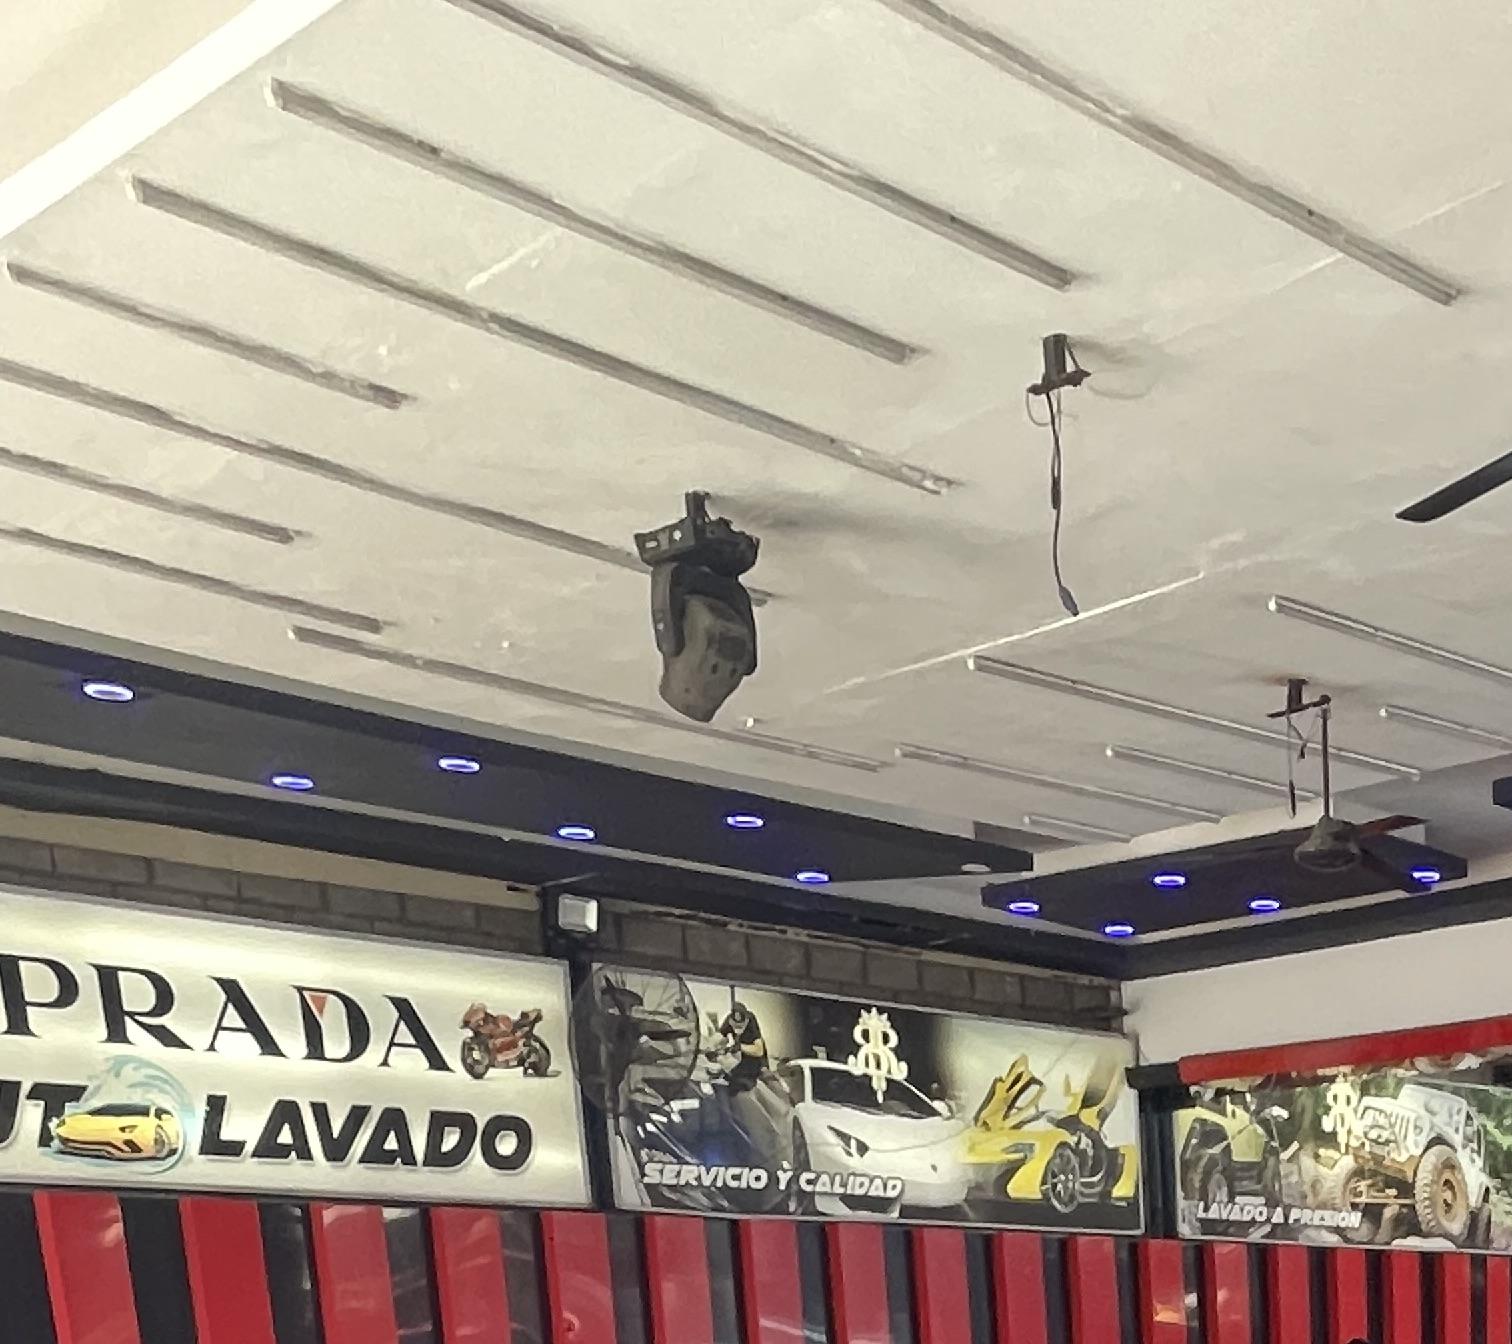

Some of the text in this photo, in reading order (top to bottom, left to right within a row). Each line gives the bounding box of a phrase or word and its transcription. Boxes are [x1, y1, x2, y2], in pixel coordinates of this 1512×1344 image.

[0, 953, 457, 1075] PRADA
[199, 1094, 533, 1171] LAVADO
[642, 1161, 902, 1198] SERVICIO Y CALIDAD
[1196, 1200, 1268, 1222] LAVADO
[1270, 1206, 1285, 1224] A
